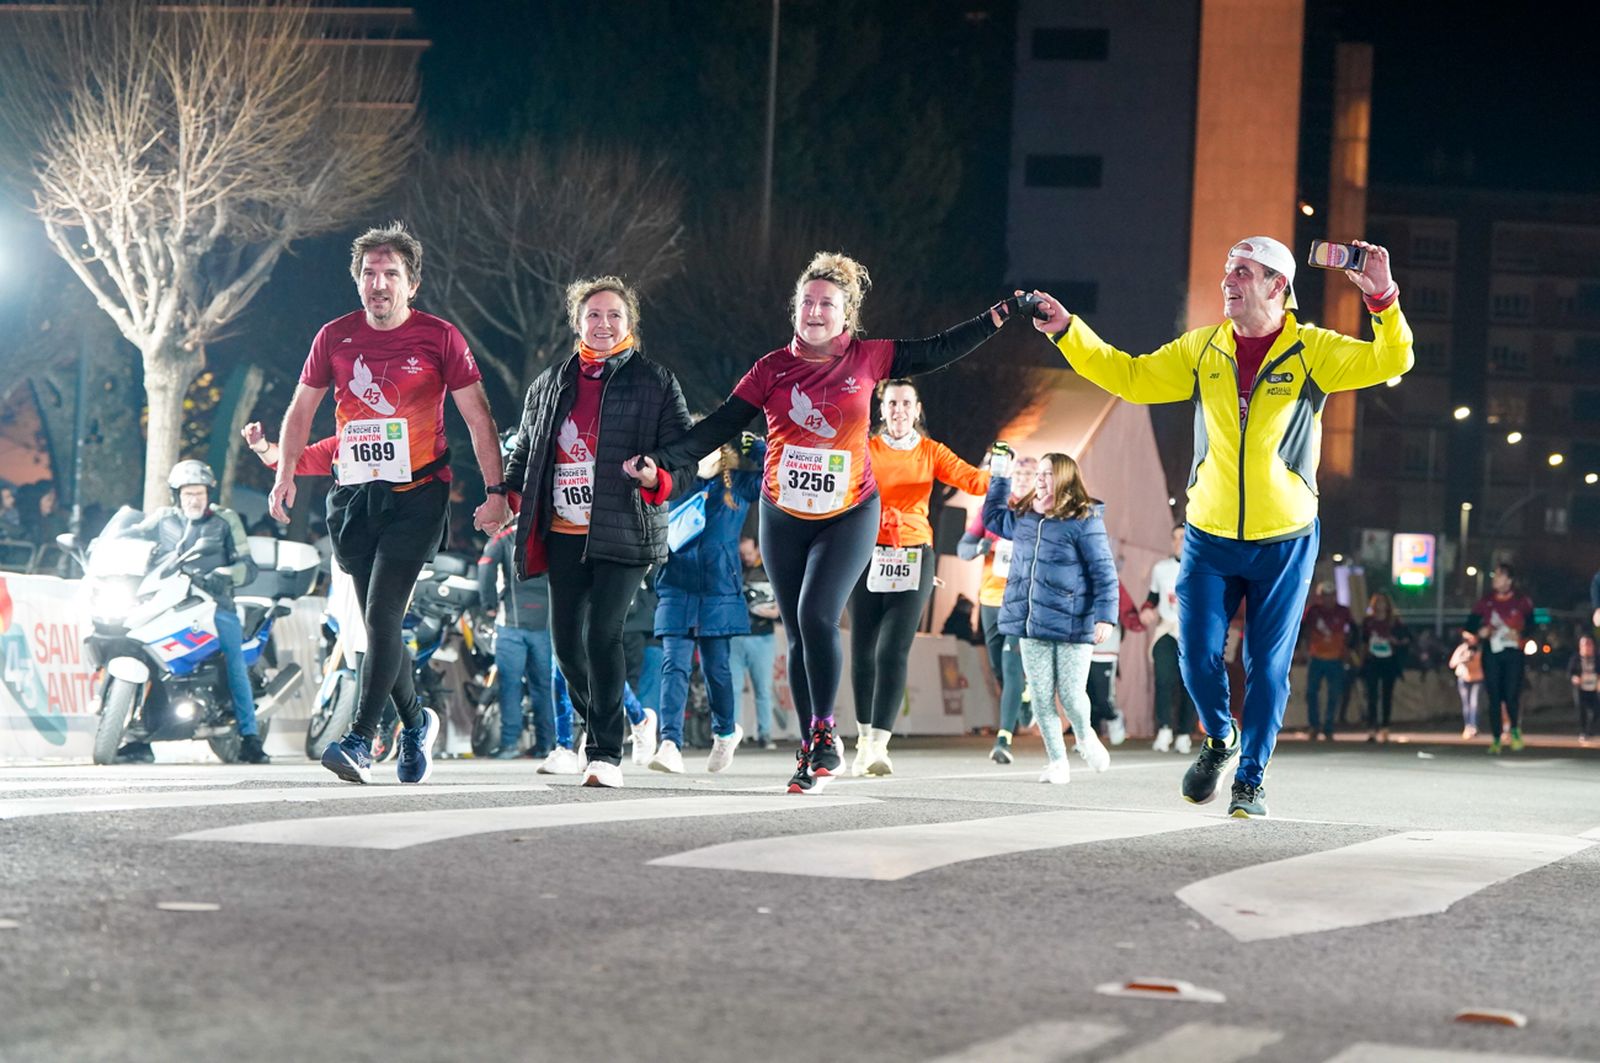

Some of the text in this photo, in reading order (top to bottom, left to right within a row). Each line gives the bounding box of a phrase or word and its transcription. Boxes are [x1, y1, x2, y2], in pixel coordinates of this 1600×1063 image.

[363, 388, 381, 405] 43
[805, 415, 822, 429] 43
[347, 434, 358, 442] SAN
[350, 442, 394, 462] 1689
[570, 443, 586, 461] 43
[786, 460, 797, 468] SAN
[788, 470, 836, 493] 3256
[880, 564, 910, 577] 7045
[34, 622, 80, 665] SAN
